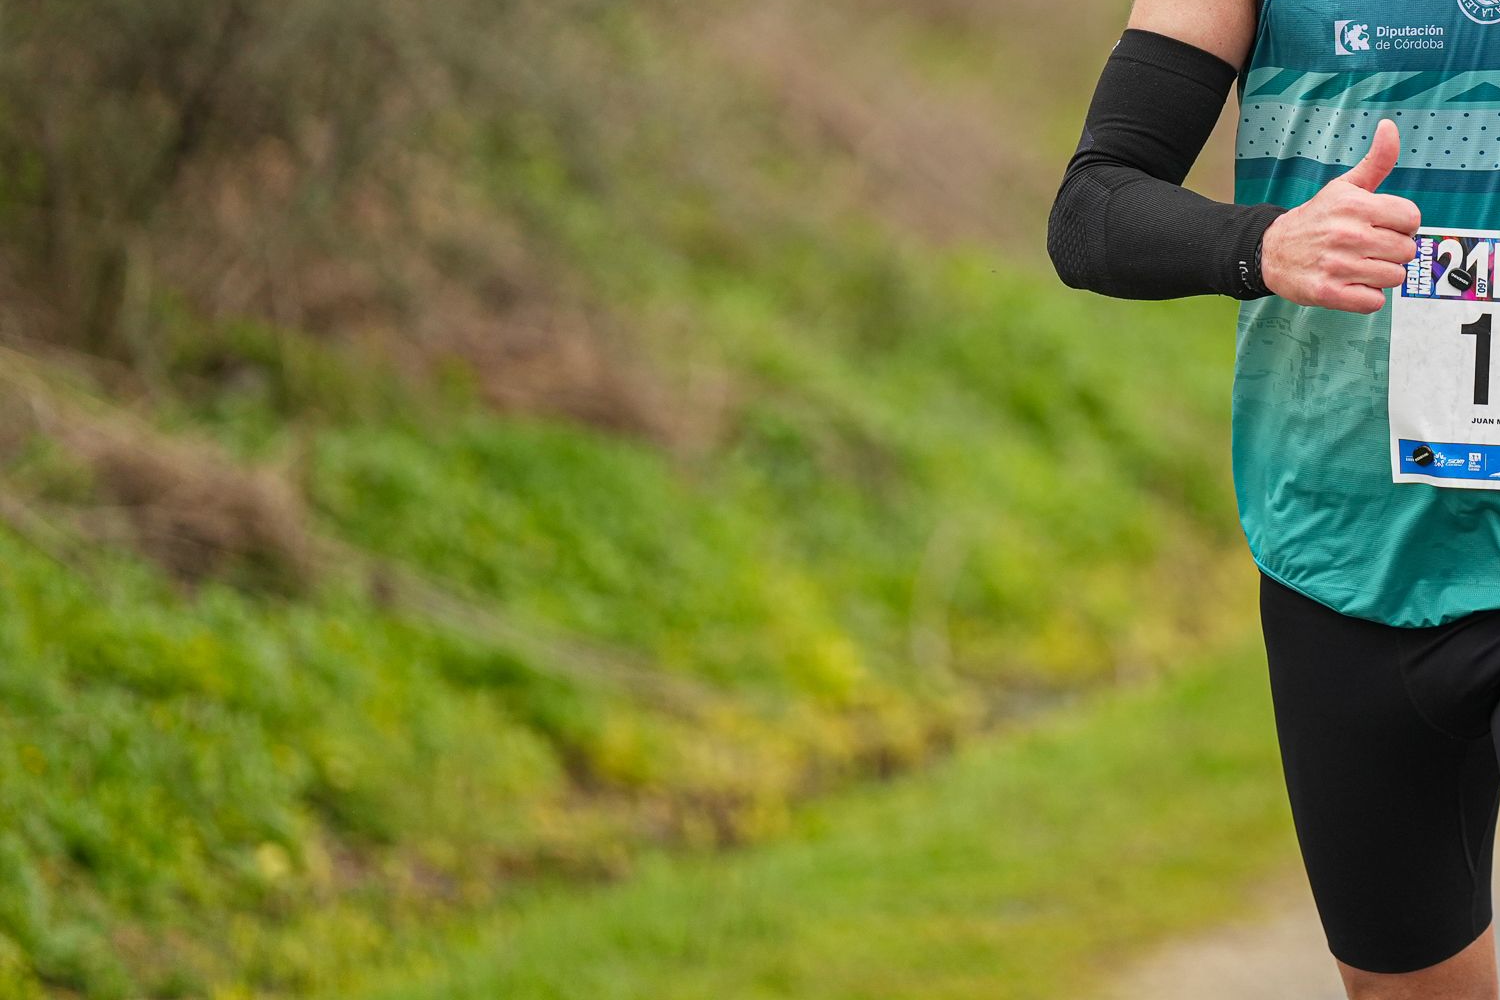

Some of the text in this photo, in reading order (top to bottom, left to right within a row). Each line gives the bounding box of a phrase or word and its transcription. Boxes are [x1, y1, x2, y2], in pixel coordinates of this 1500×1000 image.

[1376, 24, 1444, 38] Diputación
[1375, 38, 1444, 50] de Córdoba
[1418, 237, 1433, 295] MARATÓN
[1471, 417, 1494, 425] JUAN
